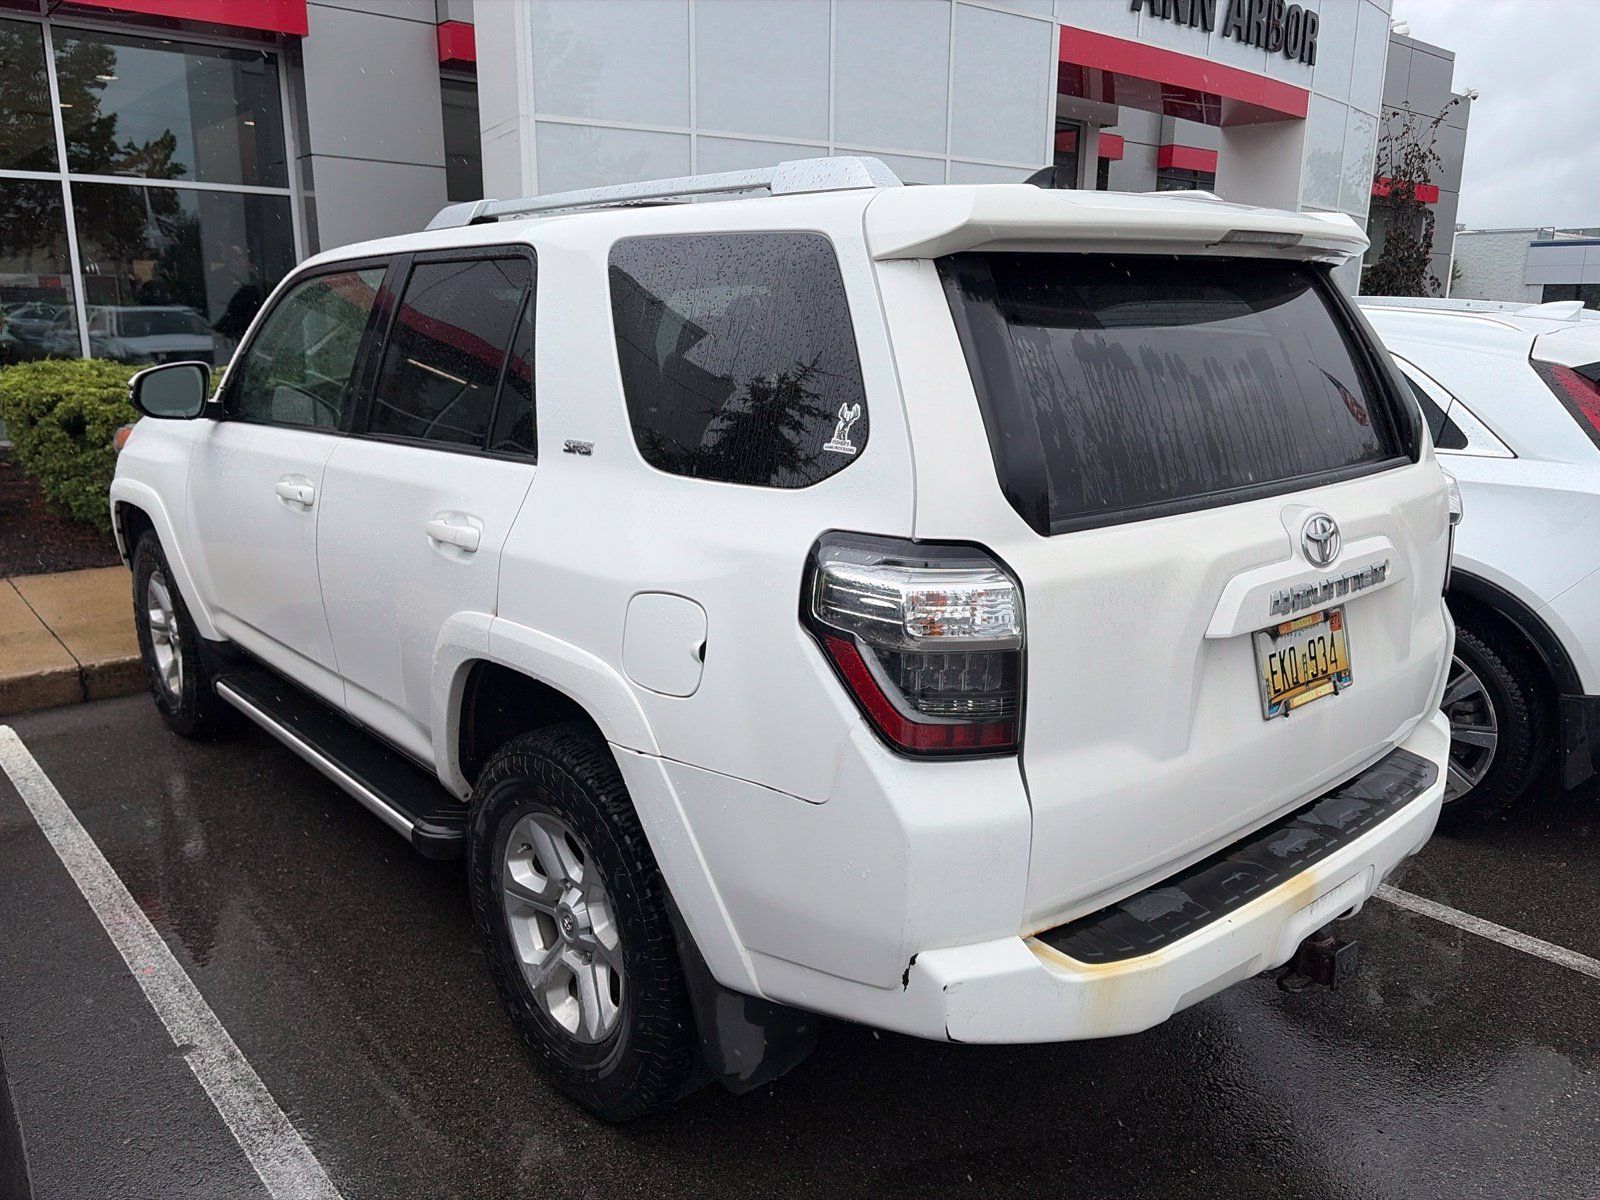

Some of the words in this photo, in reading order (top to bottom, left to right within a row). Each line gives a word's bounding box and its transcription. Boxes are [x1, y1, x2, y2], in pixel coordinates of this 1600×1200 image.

[1130, 0, 1216, 32] NN
[1222, 0, 1320, 66] ARBOR
[1268, 646, 1299, 695] EKQ
[1307, 632, 1339, 679] 934
